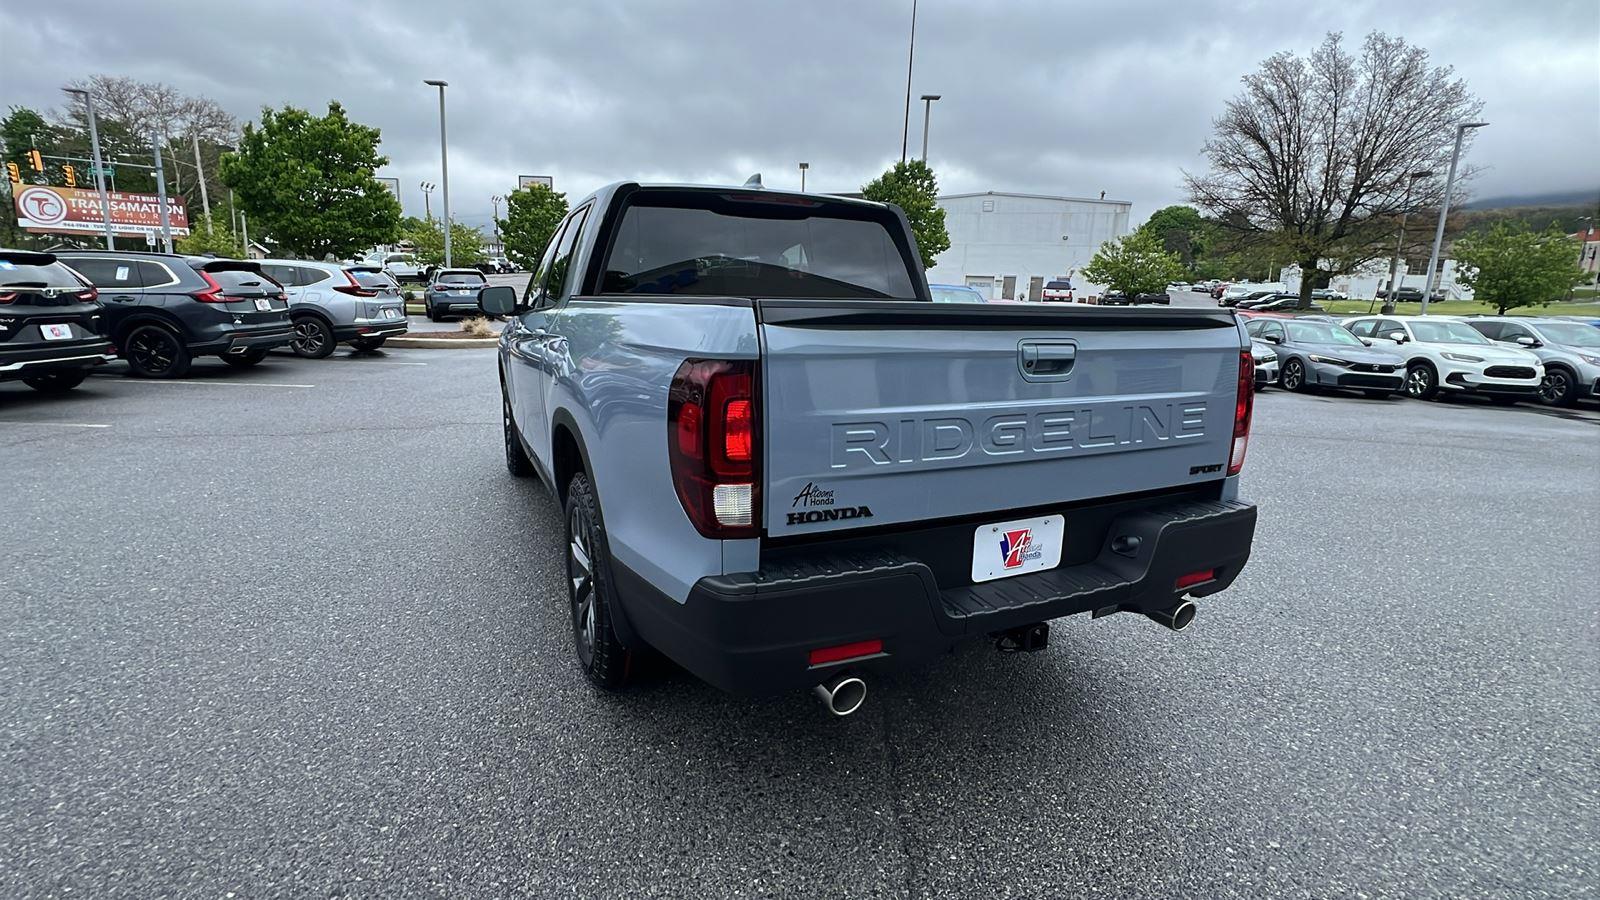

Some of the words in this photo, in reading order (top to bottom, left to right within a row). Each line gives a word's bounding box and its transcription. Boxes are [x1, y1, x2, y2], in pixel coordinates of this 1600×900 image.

[831, 401, 1207, 468] RIDGELINE
[1189, 463, 1225, 475] SPORT
[810, 497, 835, 506] Honda
[786, 506, 874, 526] HONDA
